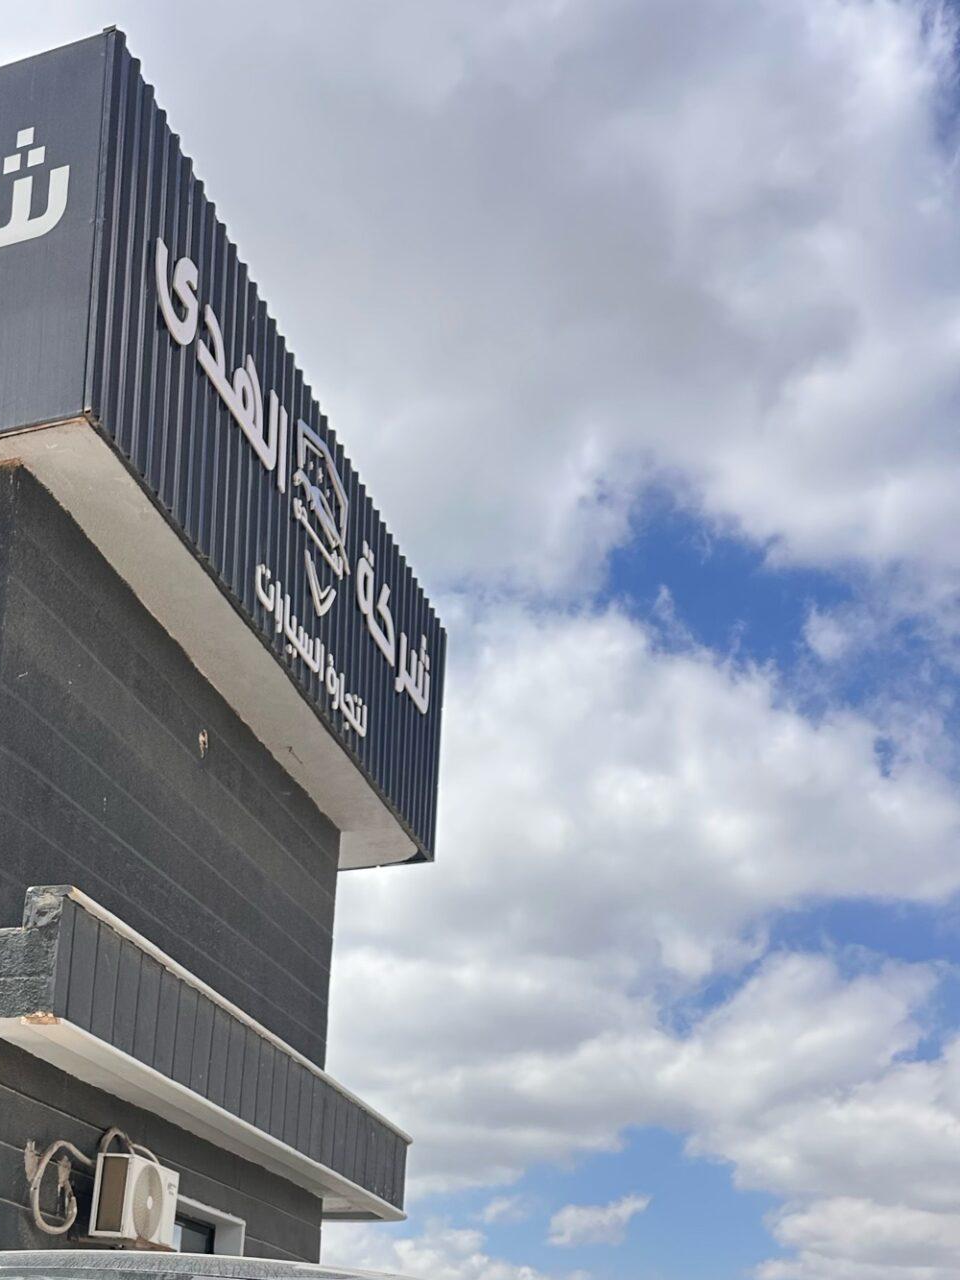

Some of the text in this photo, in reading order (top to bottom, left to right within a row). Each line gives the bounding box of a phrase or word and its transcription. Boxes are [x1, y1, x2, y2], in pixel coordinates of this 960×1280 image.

[156, 237, 431, 715] شركة الهدى
[255, 564, 368, 738] لتجارة السيارات
